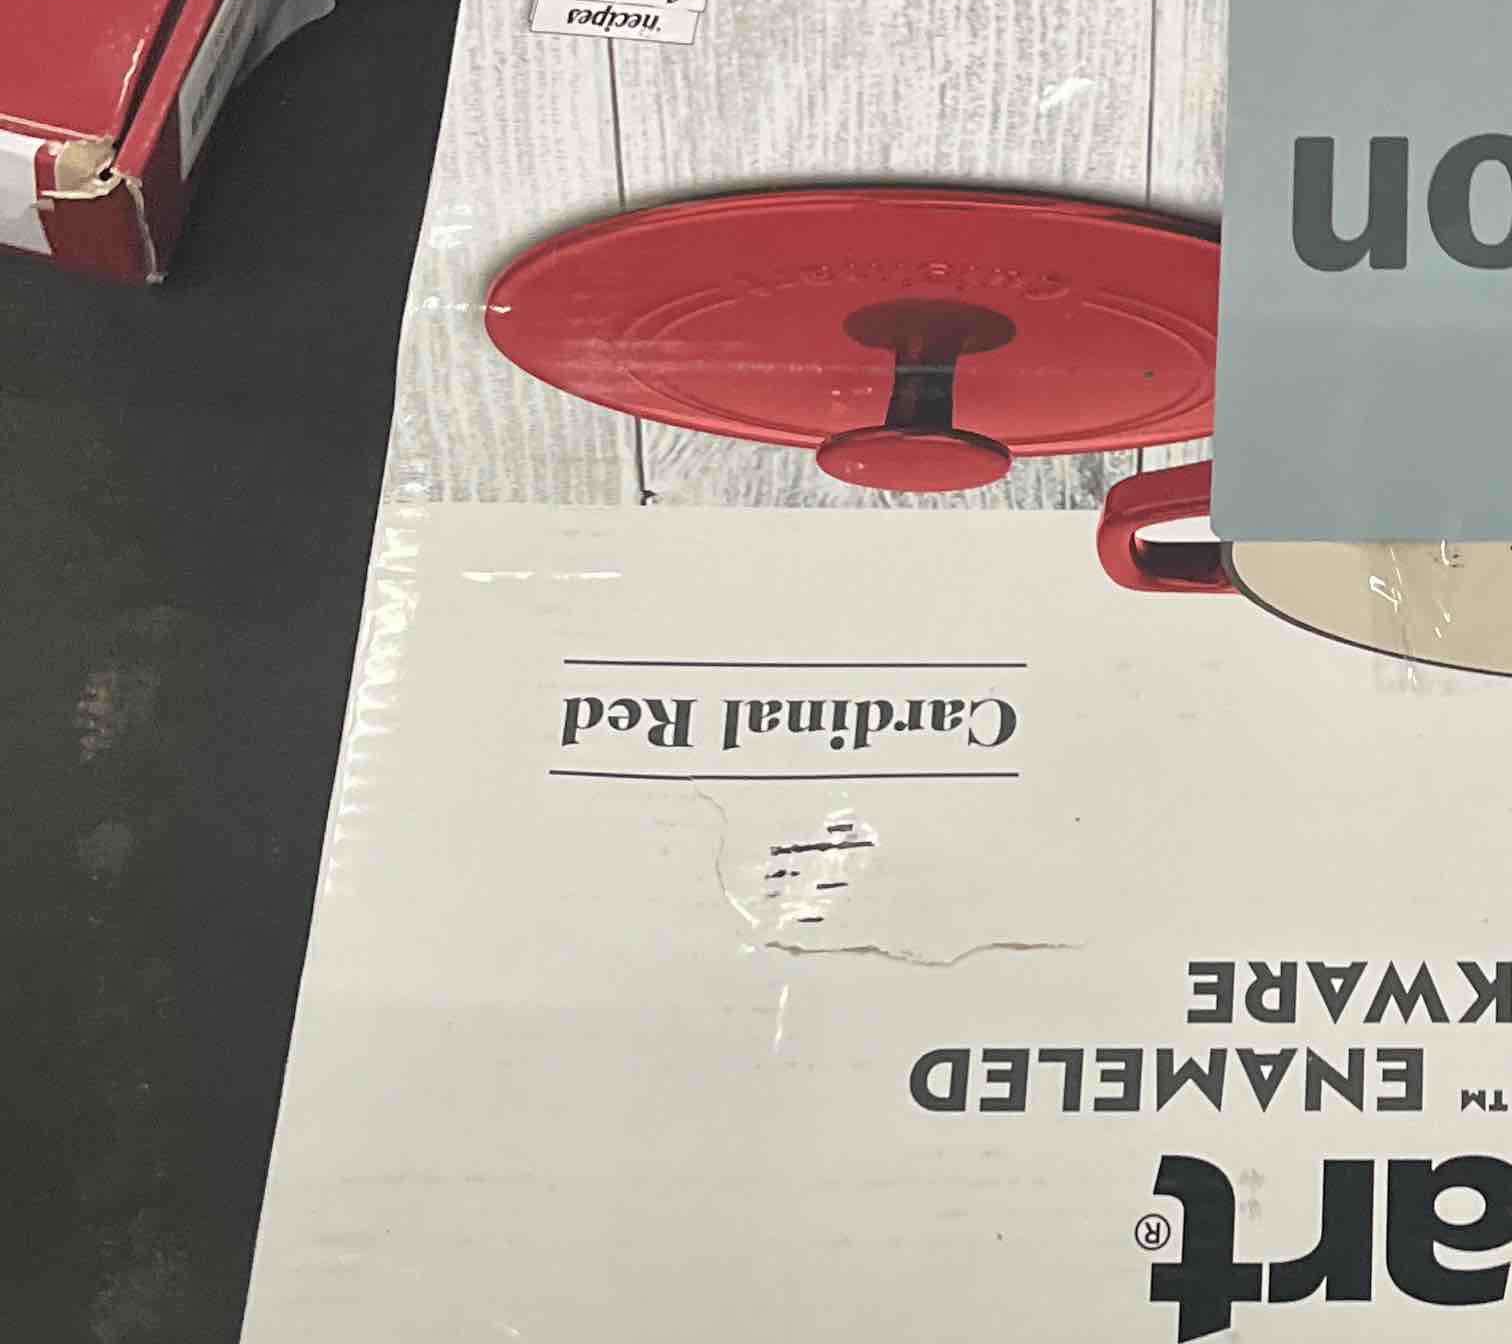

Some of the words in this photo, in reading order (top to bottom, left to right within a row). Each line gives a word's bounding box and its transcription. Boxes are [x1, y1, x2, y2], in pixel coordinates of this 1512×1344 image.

[561, 697, 697, 749] Red
[722, 698, 1018, 752] Cardinal
[909, 1046, 1425, 1114] ENAMELED
